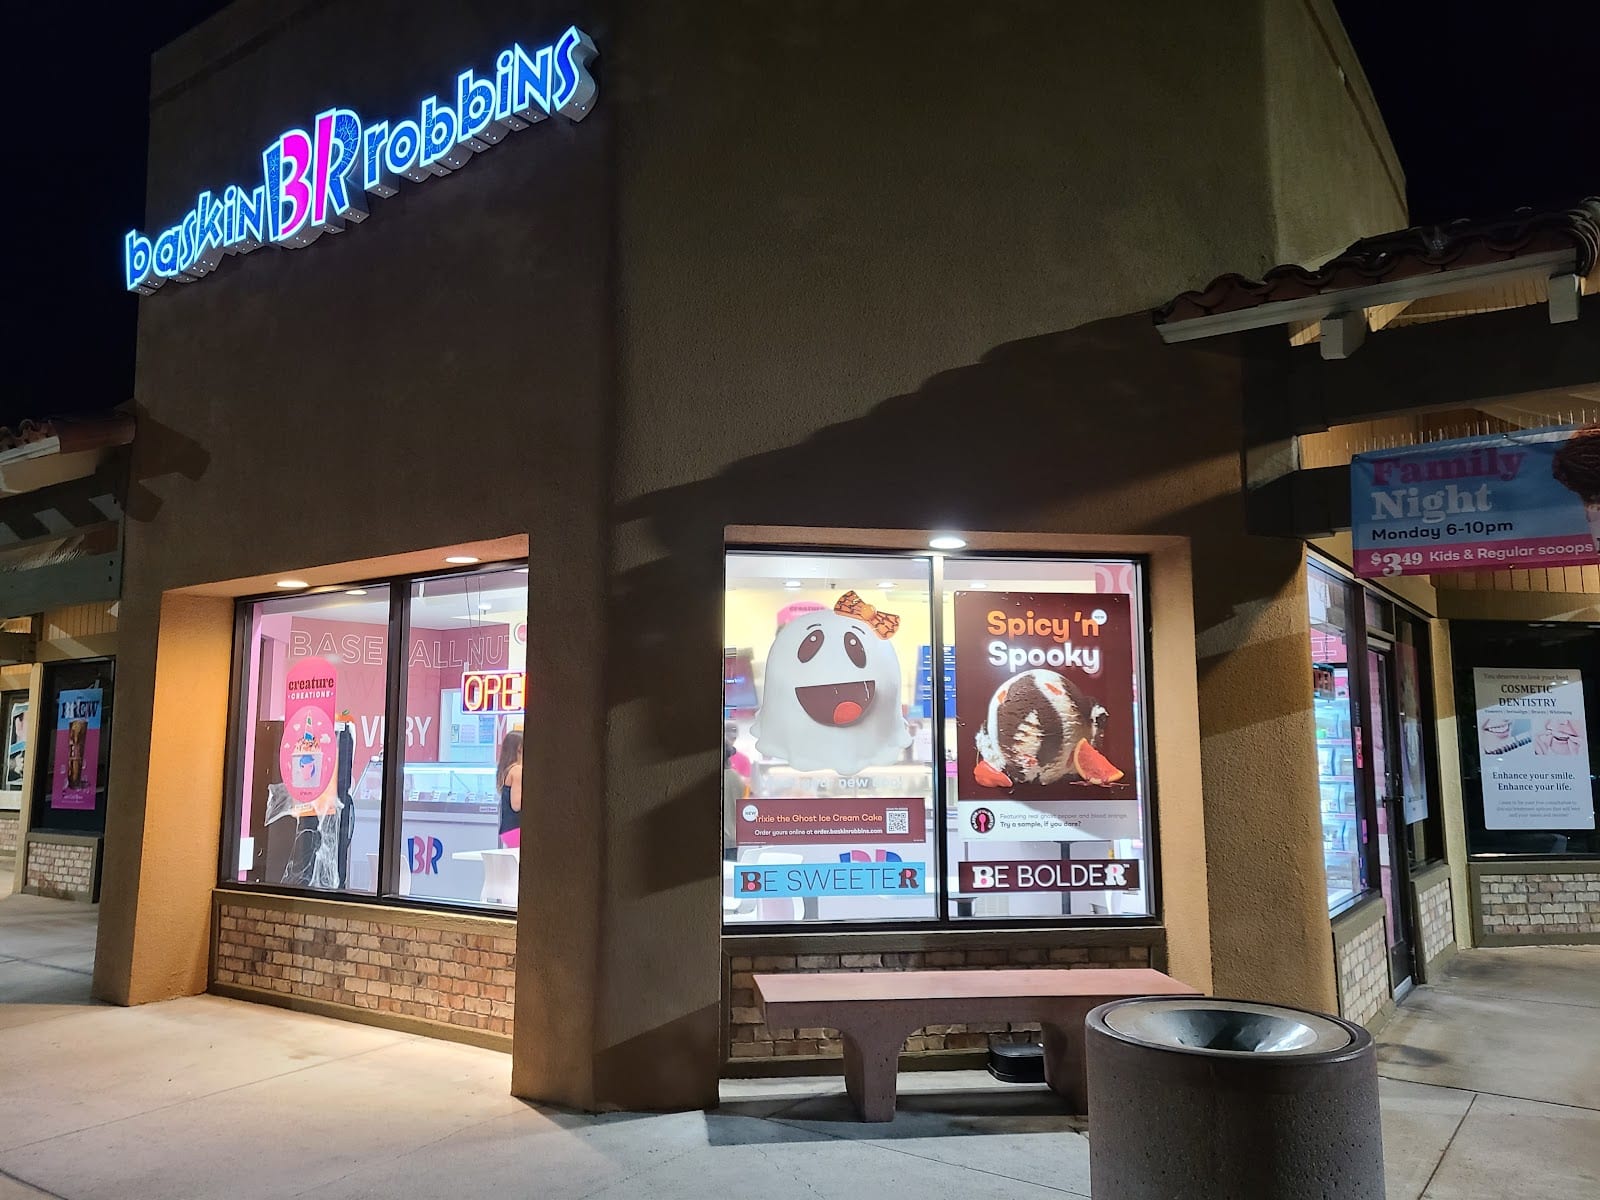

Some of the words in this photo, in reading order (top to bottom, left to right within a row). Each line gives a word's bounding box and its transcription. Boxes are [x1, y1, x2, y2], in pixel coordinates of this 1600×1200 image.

[262, 107, 362, 241] BR
[1371, 447, 1528, 486] Family
[1371, 483, 1493, 523] Night
[1372, 526, 1441, 541] Monday
[1446, 520, 1514, 536] 6-10pm
[1429, 549, 1460, 562] Kids
[1463, 549, 1474, 560] &
[1477, 544, 1533, 561] Regular
[1537, 541, 1593, 556] scoops
[987, 610, 1070, 643] Spicy
[988, 641, 1101, 675] Spooky
[288, 676, 334, 690] creature
[464, 673, 526, 712] OPE
[1501, 684, 1553, 693] COSMETIC
[290, 690, 331, 700] CREATIONS
[1498, 697, 1557, 707] DENTISTRY
[1492, 771, 1528, 780] Enhance
[1529, 773, 1549, 781] your
[1550, 771, 1576, 780] smile.
[1498, 782, 1534, 791] Enhance
[1535, 784, 1555, 792] your
[1556, 782, 1572, 791] life.
[755, 814, 775, 823] Trixie
[777, 814, 791, 823] the
[792, 813, 817, 823] Ghost
[818, 814, 831, 822] Ice
[832, 813, 860, 822] Cream
[861, 813, 883, 822] Cake
[1000, 821, 1011, 829] Try
[1017, 821, 1043, 829] sample,
[788, 828, 806, 836] online
[407, 835, 444, 876] BR
[740, 870, 778, 893] BE
[787, 867, 919, 891] SWEETER
[972, 865, 1010, 888] BE
[1017, 862, 1127, 887] BOLDER
